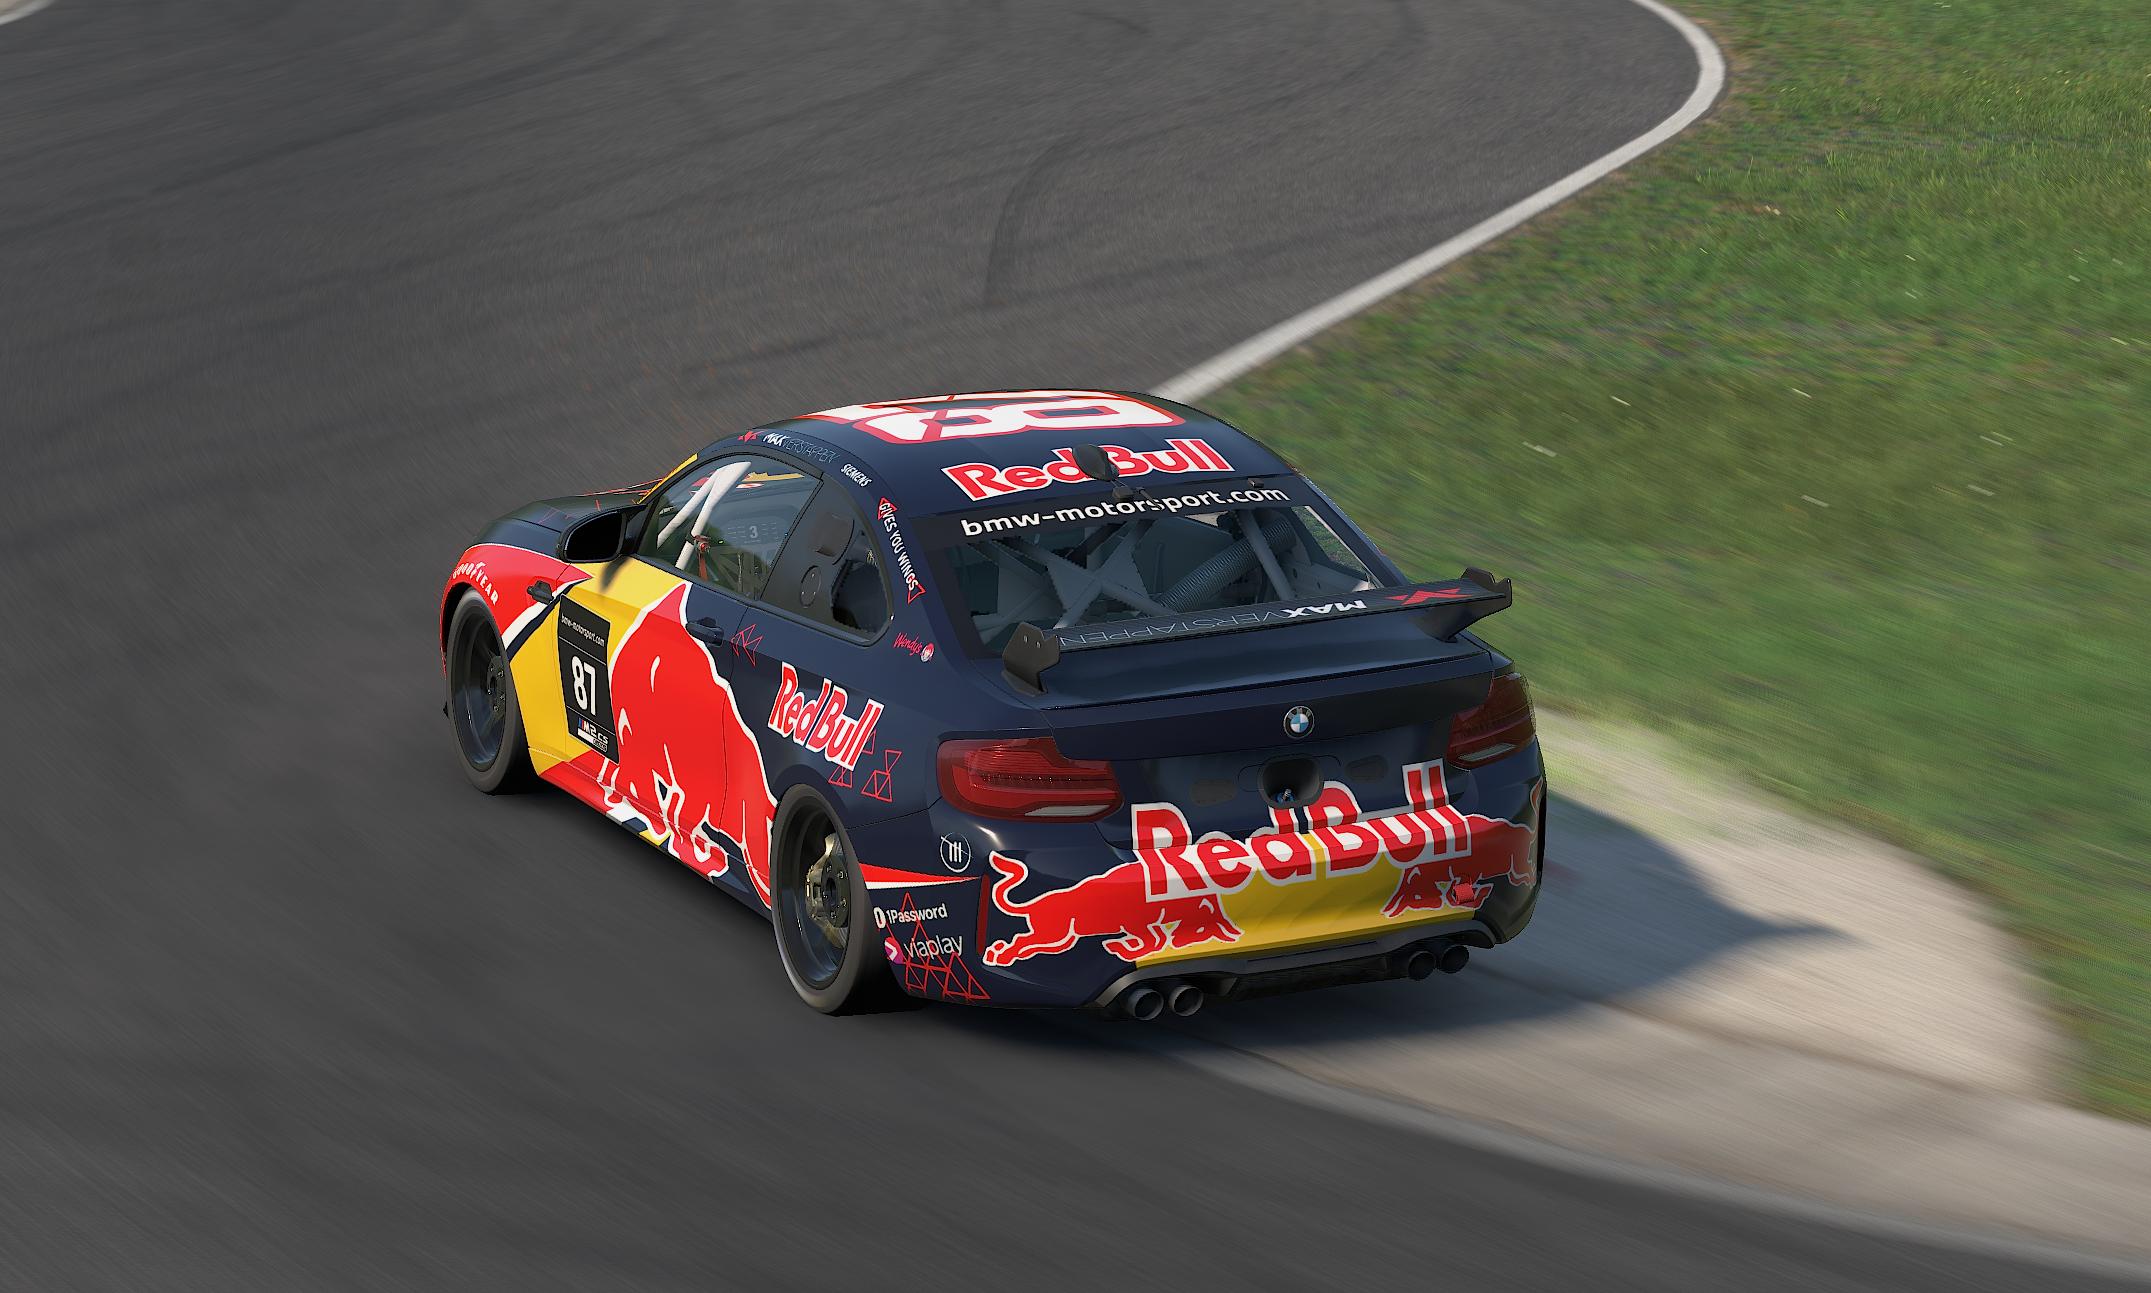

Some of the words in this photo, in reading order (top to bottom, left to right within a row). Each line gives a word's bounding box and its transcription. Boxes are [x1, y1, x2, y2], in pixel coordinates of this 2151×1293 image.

[840, 463, 872, 487] SIEMENS
[961, 486, 1290, 537] bmw-motorsport.com
[879, 502, 897, 532] GIVES
[889, 529, 904, 554] YOU
[897, 551, 918, 591] WINGS
[572, 655, 596, 716] 87
[768, 661, 832, 746] Red
[805, 685, 884, 771] Bull
[1131, 802, 1317, 903] Red
[1304, 758, 1473, 879] Bull
[886, 904, 948, 925] 1Password
[904, 935, 963, 960] viaplay
